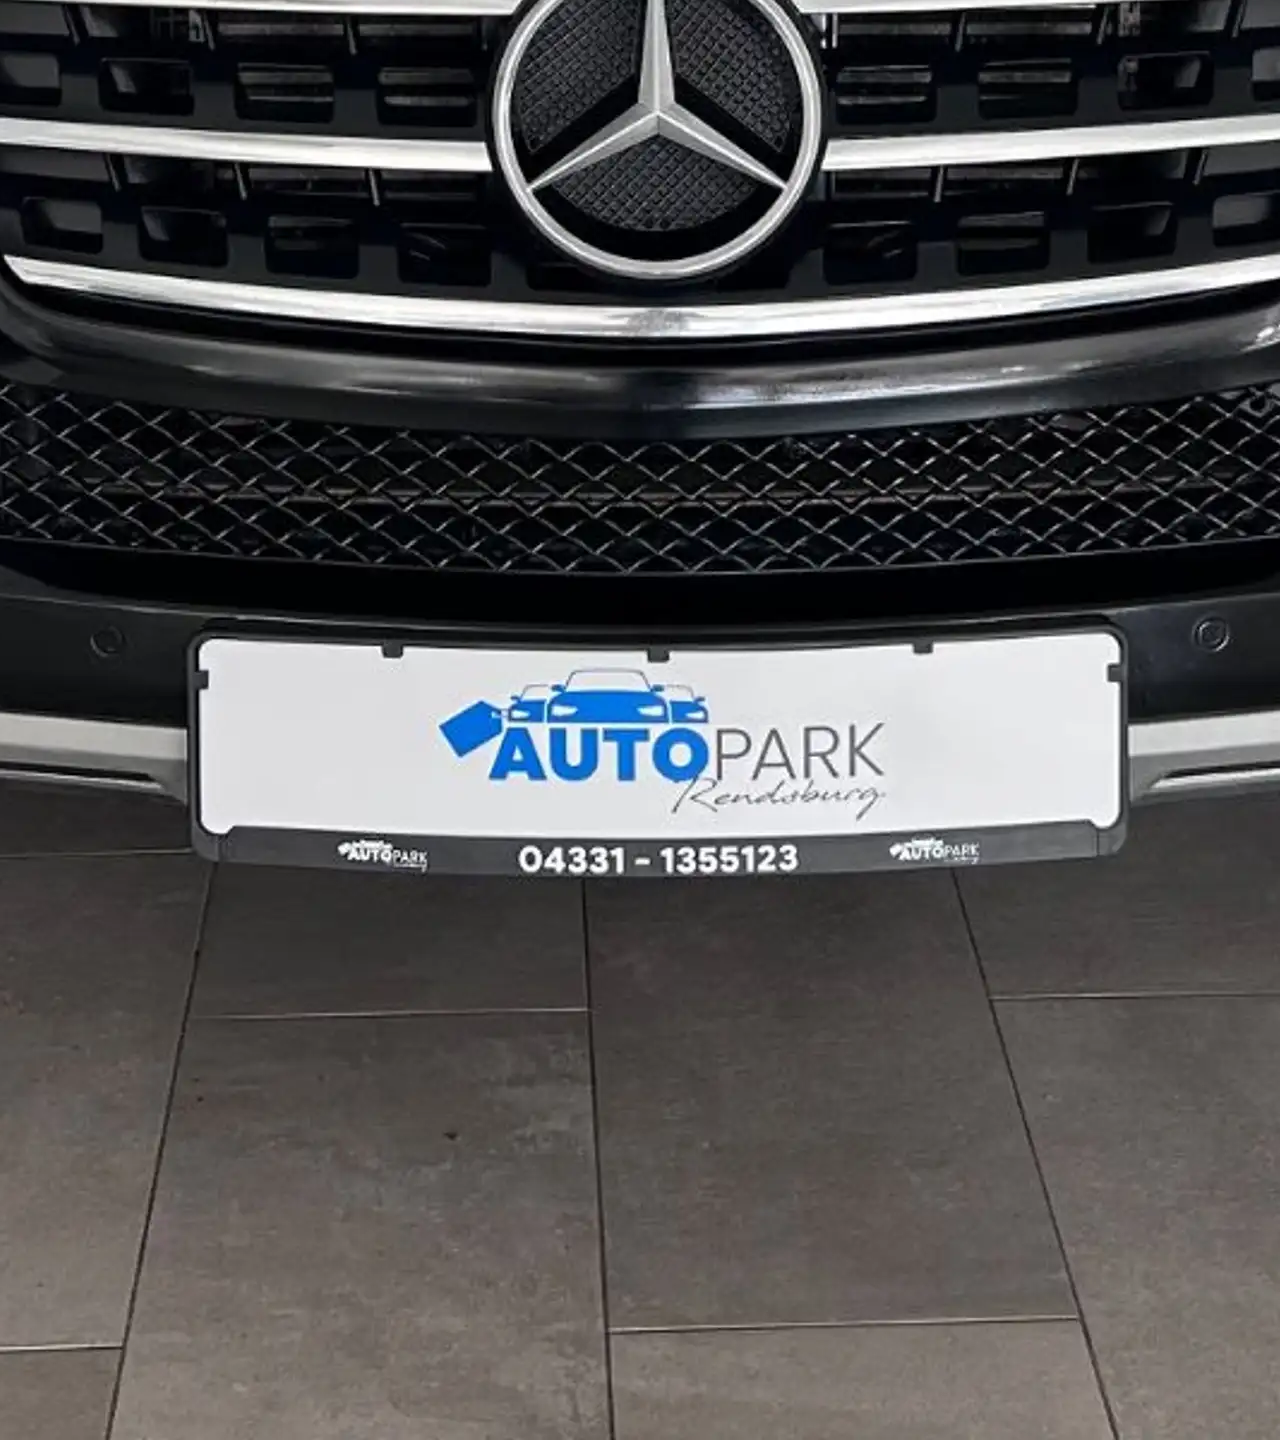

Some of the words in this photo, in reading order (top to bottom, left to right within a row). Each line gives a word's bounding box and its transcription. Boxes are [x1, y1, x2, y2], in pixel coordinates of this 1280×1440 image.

[670, 773, 887, 821] Rendsburg
[518, 845, 626, 874] 04331
[659, 844, 799, 874] 1355123
